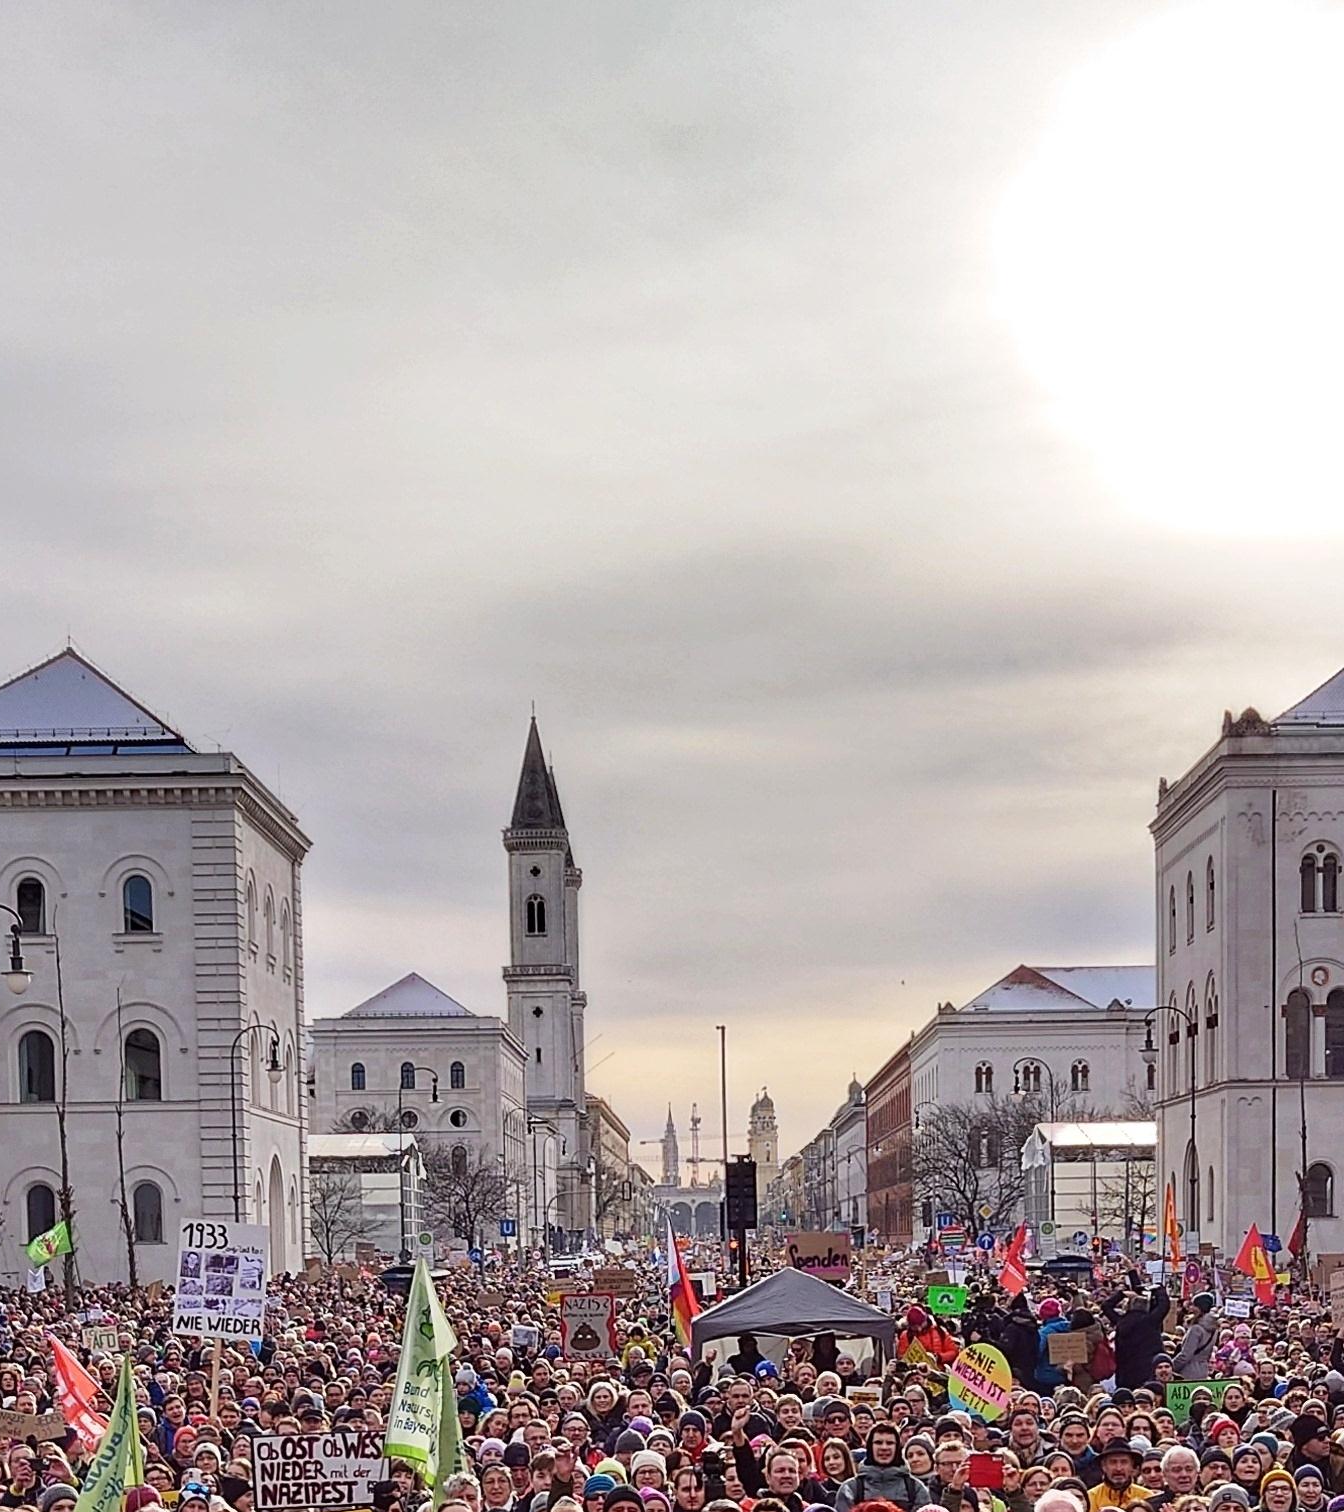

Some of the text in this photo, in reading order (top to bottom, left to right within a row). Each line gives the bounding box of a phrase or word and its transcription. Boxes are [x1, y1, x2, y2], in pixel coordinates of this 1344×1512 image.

[182, 1222, 229, 1250] 1933
[503, 1222, 513, 1234] U
[176, 1315, 261, 1336] NIE WIEDER
[966, 1347, 997, 1374] #NIE
[403, 1381, 430, 1398] Bund
[956, 1358, 1006, 1401] WIEDER IST
[258, 1442, 280, 1460] Ob
[281, 1436, 320, 1460] OST
[323, 1434, 343, 1458] Ob
[261, 1460, 371, 1482] NIEDER mit der
[261, 1481, 358, 1506] NAZIPEST
